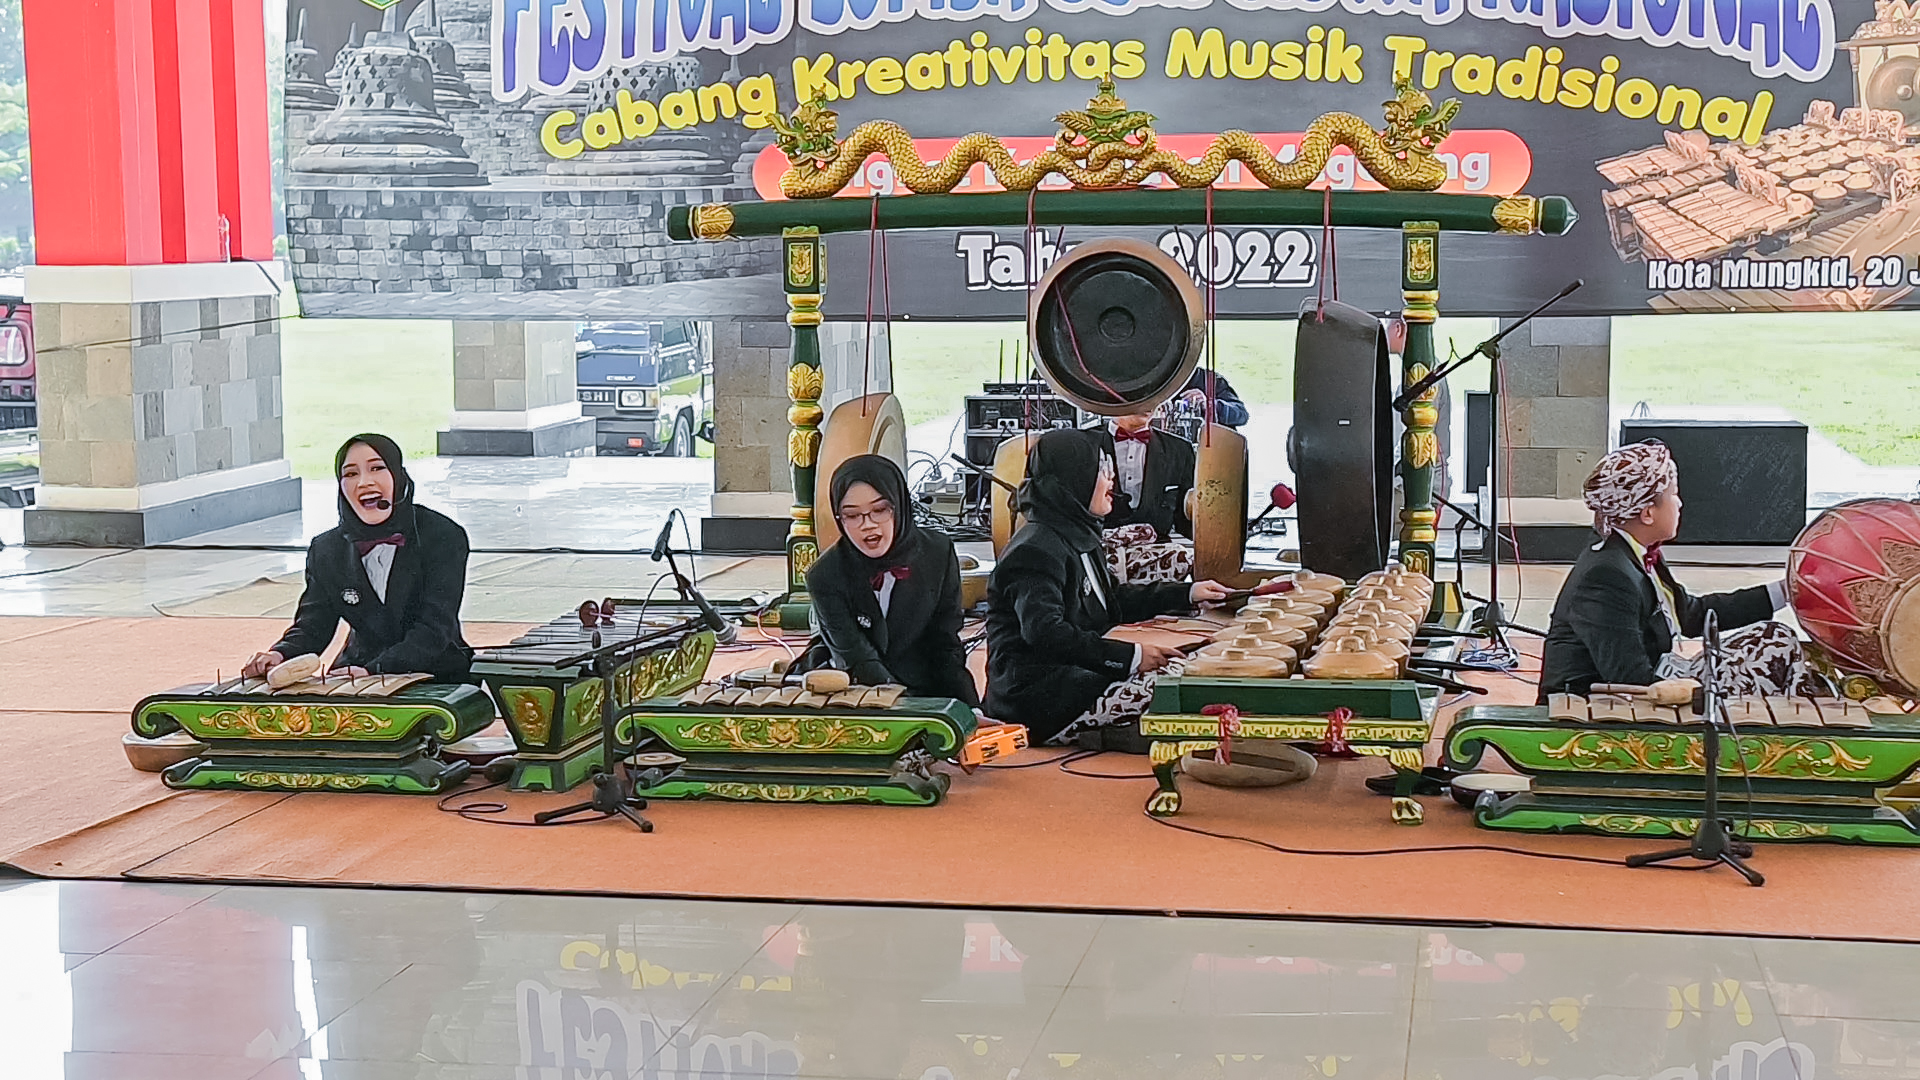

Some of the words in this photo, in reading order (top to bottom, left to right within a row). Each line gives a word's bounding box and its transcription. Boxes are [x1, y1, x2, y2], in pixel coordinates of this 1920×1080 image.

[540, 72, 779, 160] Cabang
[791, 27, 1147, 106] Kreativitas
[1163, 25, 1364, 84] Musik
[1383, 34, 1774, 146] Tradisional
[1648, 258, 1713, 291] Kota
[1719, 256, 1856, 290] Mungkid,
[1864, 256, 1903, 288] 20
